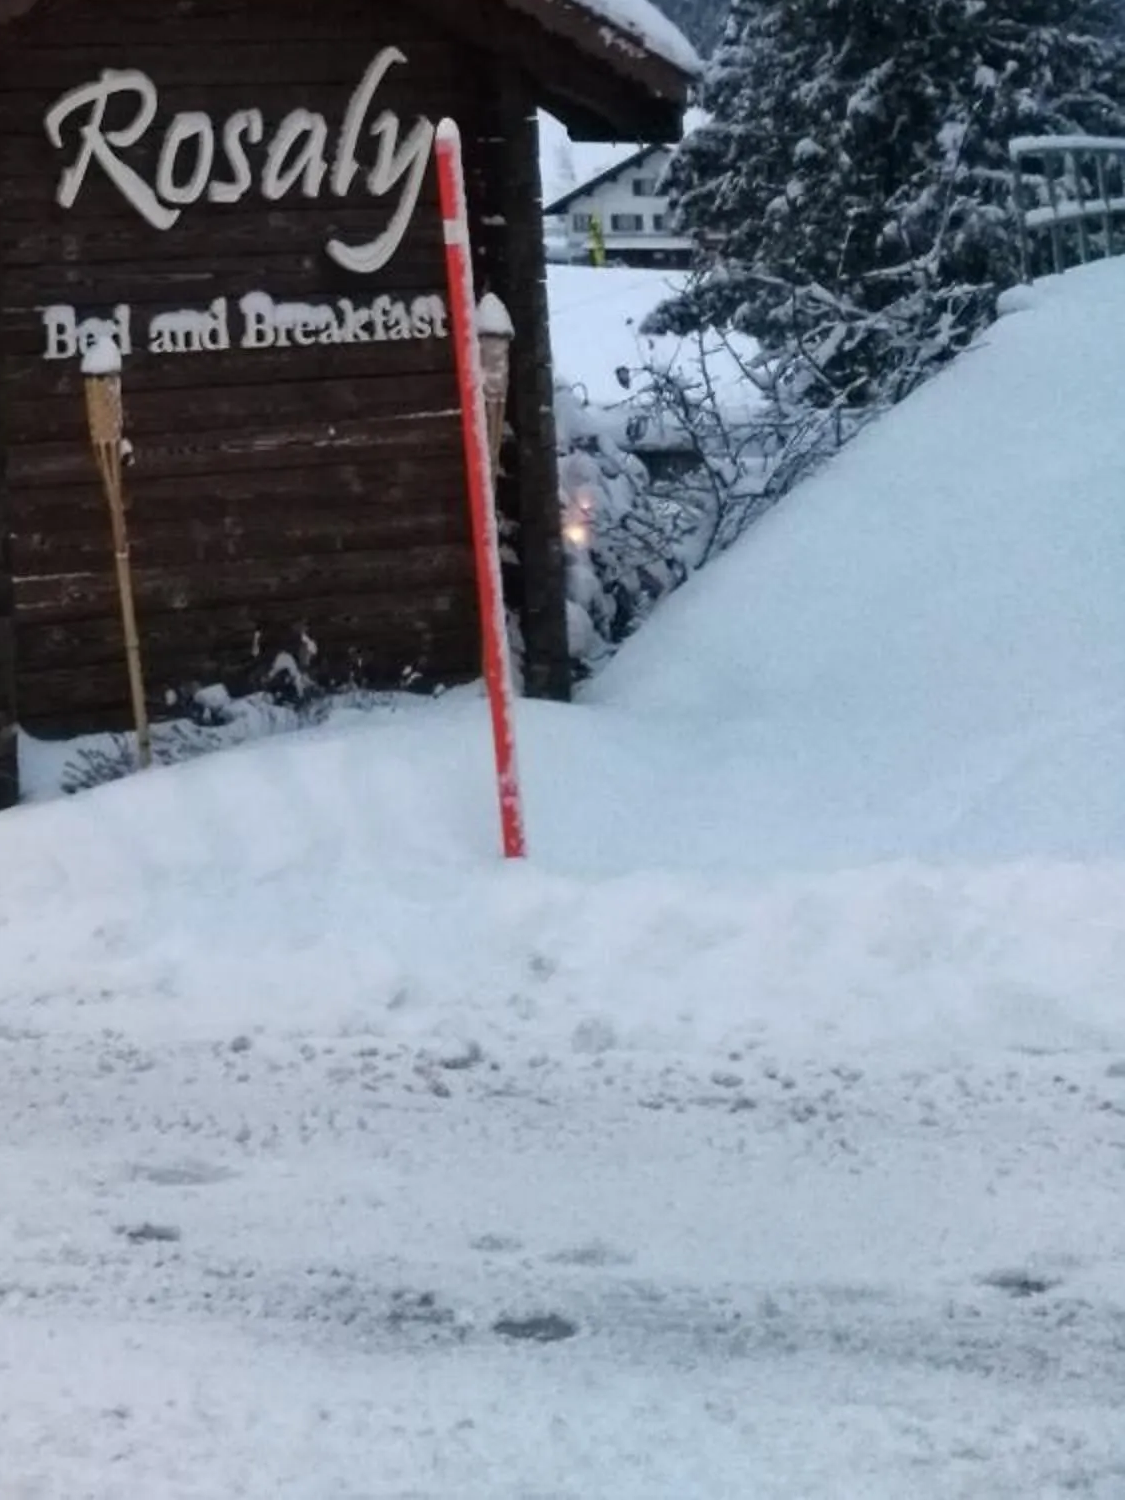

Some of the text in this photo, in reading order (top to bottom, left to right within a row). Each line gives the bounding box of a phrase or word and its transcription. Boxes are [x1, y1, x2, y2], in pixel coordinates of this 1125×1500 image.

[44, 45, 434, 273] Rosaly
[148, 297, 230, 353] and
[239, 291, 448, 349] Breakfast
